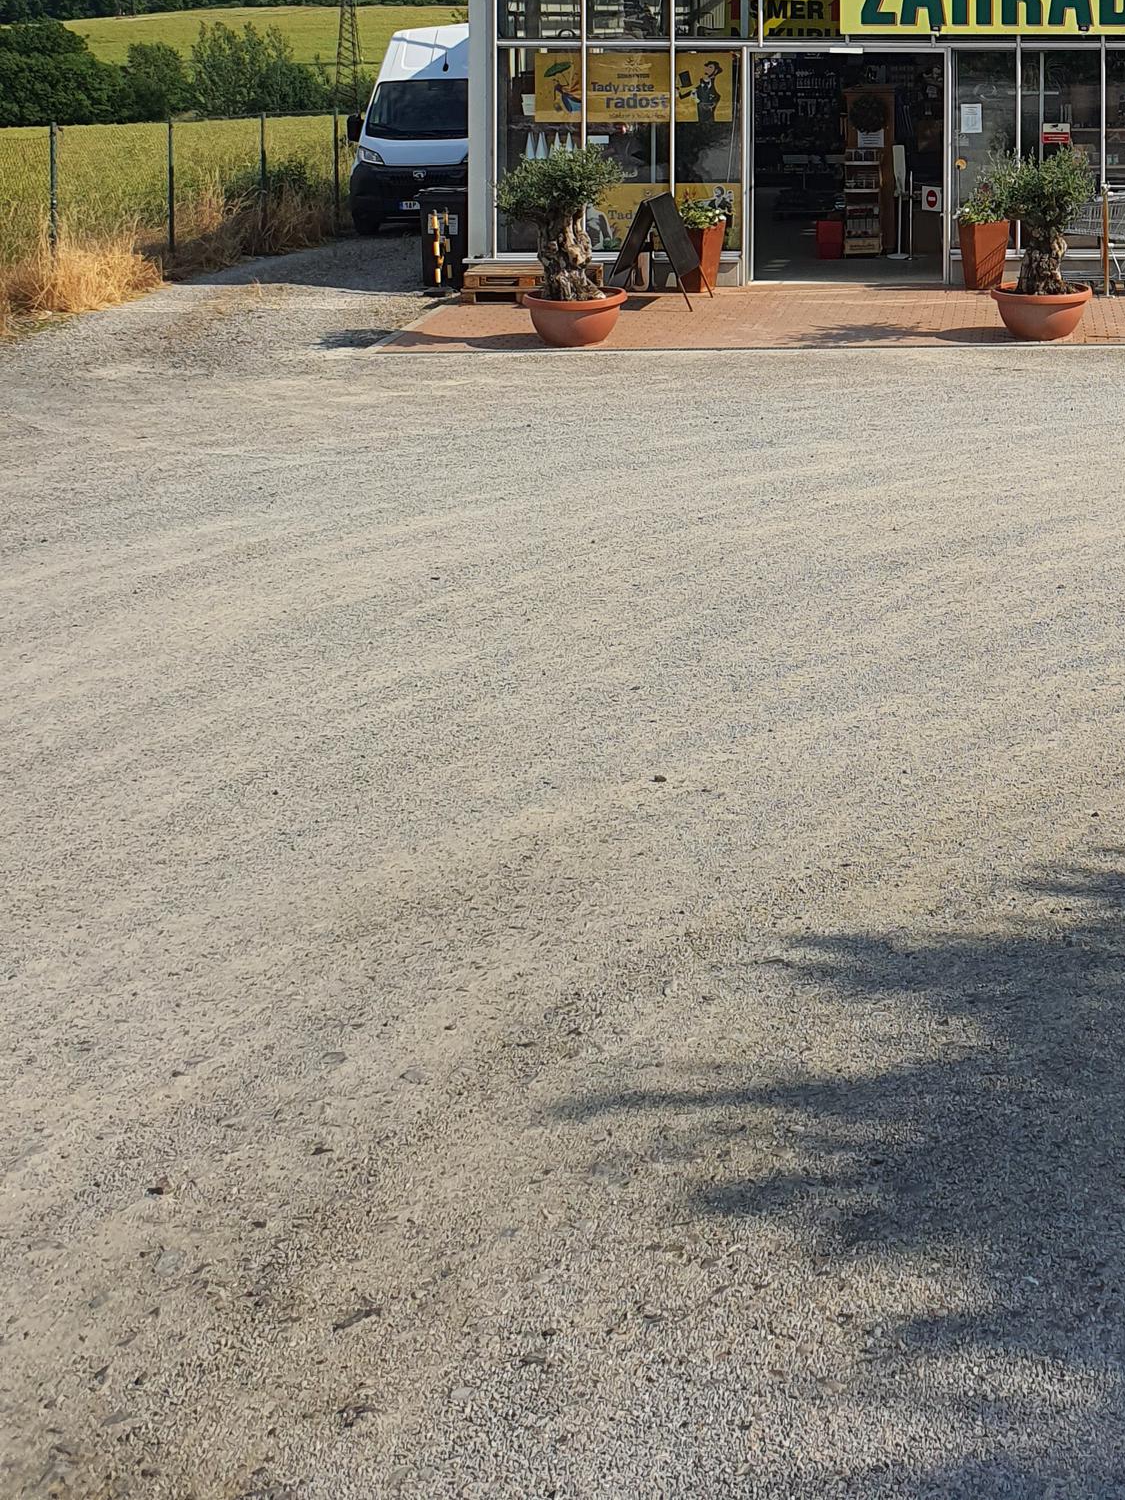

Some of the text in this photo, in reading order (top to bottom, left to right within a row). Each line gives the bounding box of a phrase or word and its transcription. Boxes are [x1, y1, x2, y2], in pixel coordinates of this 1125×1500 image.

[591, 81, 655, 94] Tady roste
[606, 93, 669, 109] radost
[608, 210, 635, 220] Tad
